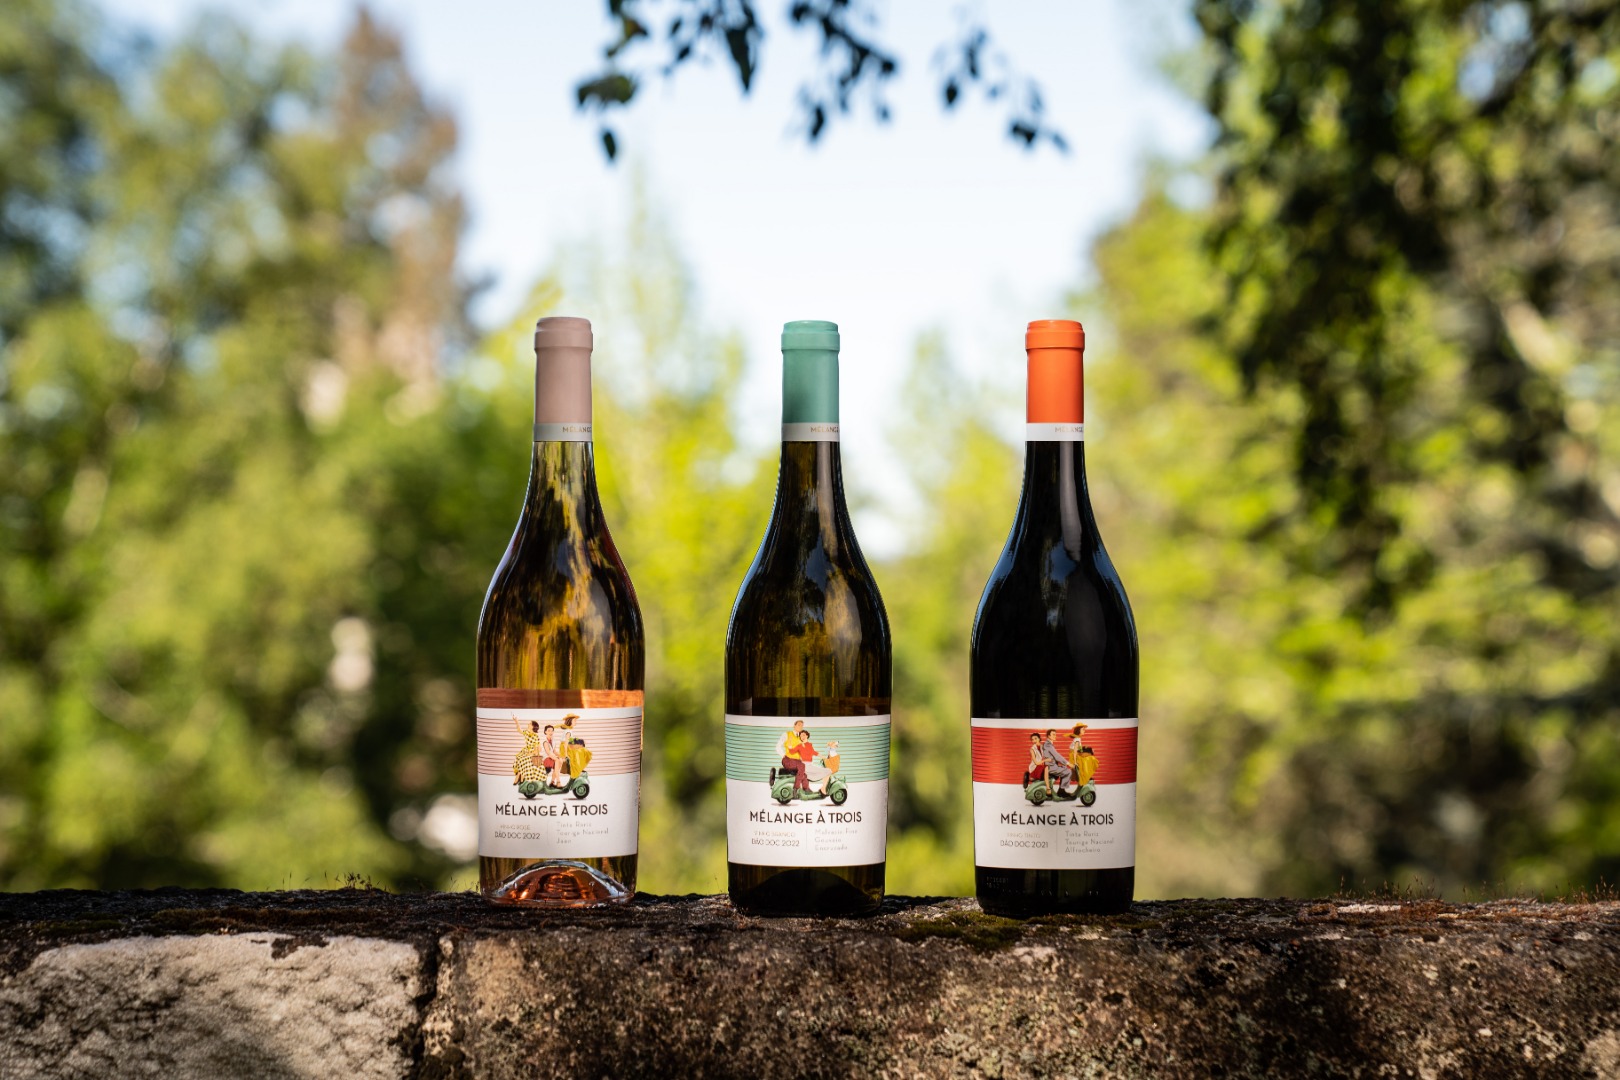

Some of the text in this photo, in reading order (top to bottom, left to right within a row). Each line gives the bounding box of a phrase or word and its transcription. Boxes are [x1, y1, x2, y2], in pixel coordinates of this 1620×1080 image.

[495, 802, 608, 817] MÉLANGE À TROIS
[749, 808, 862, 824] MÉLANGE À TROIS
[1000, 811, 1114, 826] MÉLANGE À TROIS
[507, 831, 521, 839] DOC
[522, 832, 541, 840] 2022
[765, 838, 780, 847] DOC
[781, 839, 800, 847] 2022
[1014, 840, 1030, 848] DOC
[1031, 840, 1049, 848] 2021
